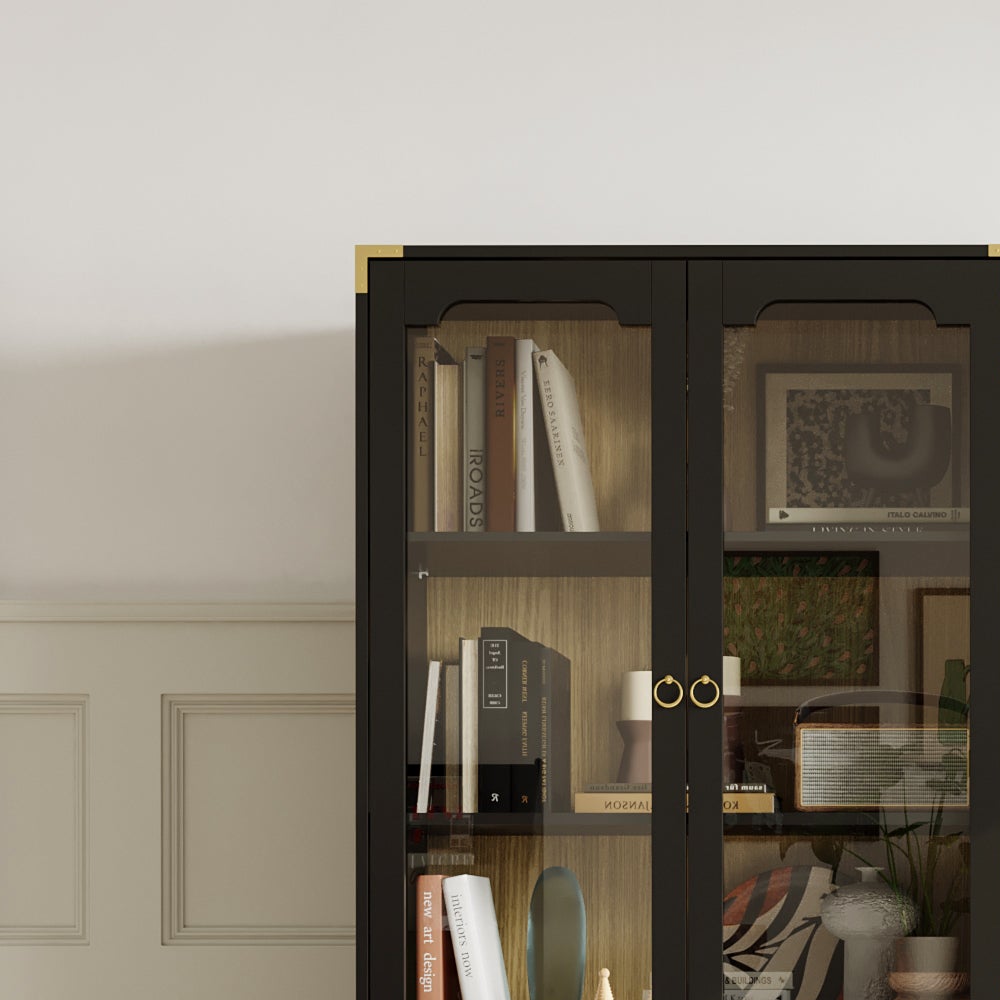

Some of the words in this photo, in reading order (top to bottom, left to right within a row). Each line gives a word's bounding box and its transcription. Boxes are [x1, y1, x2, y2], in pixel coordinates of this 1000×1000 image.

[418, 356, 429, 457] RAPHAEL
[496, 359, 505, 418] RIVERS
[543, 379, 554, 408] EERO
[548, 411, 565, 467] SAARINEN
[887, 511, 910, 519] ITALO
[912, 511, 947, 519] CALVINO
[423, 891, 433, 919] new
[423, 926, 433, 944] art
[450, 894, 468, 946] interiors
[461, 952, 474, 978] now
[419, 952, 437, 993] design
